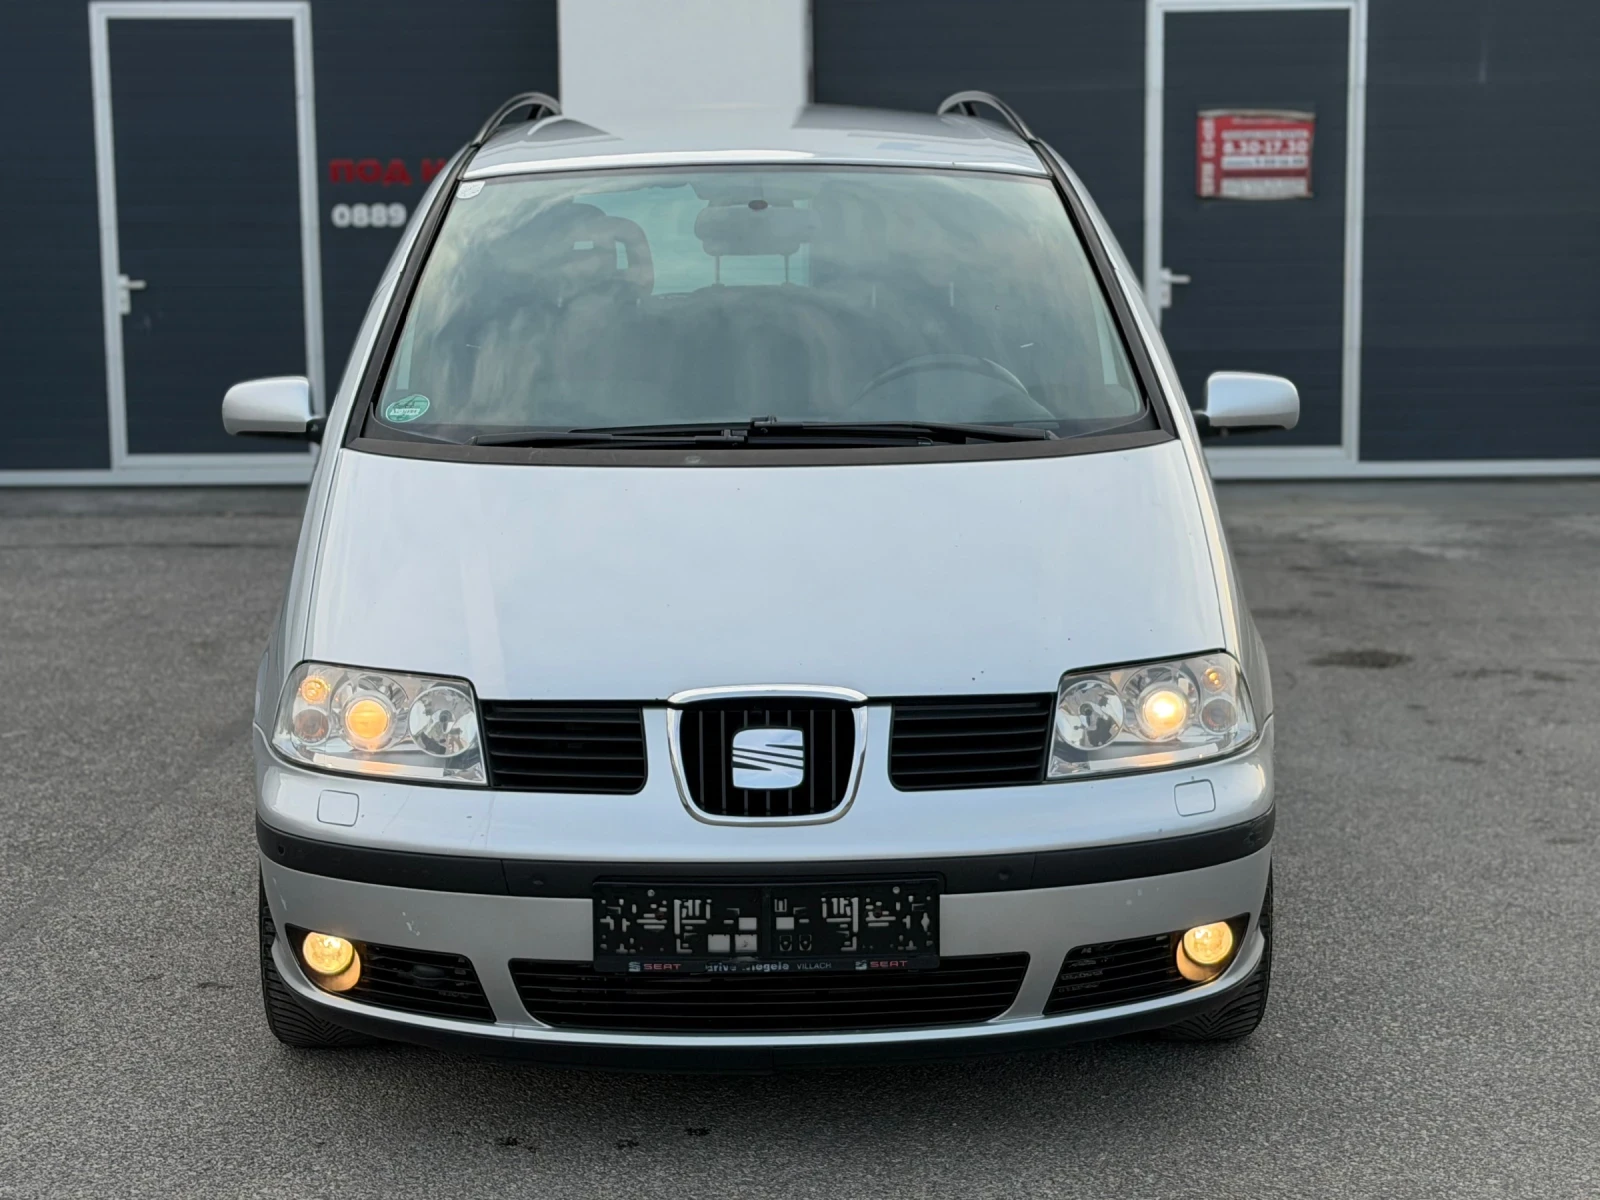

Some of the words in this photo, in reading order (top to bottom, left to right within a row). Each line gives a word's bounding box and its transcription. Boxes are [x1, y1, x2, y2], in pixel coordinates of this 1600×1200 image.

[329, 158, 412, 186] ПОД
[331, 202, 407, 228] 0889
[643, 962, 681, 970] SEAT
[796, 961, 832, 970] VILLACH
[869, 960, 908, 968] SEAT
